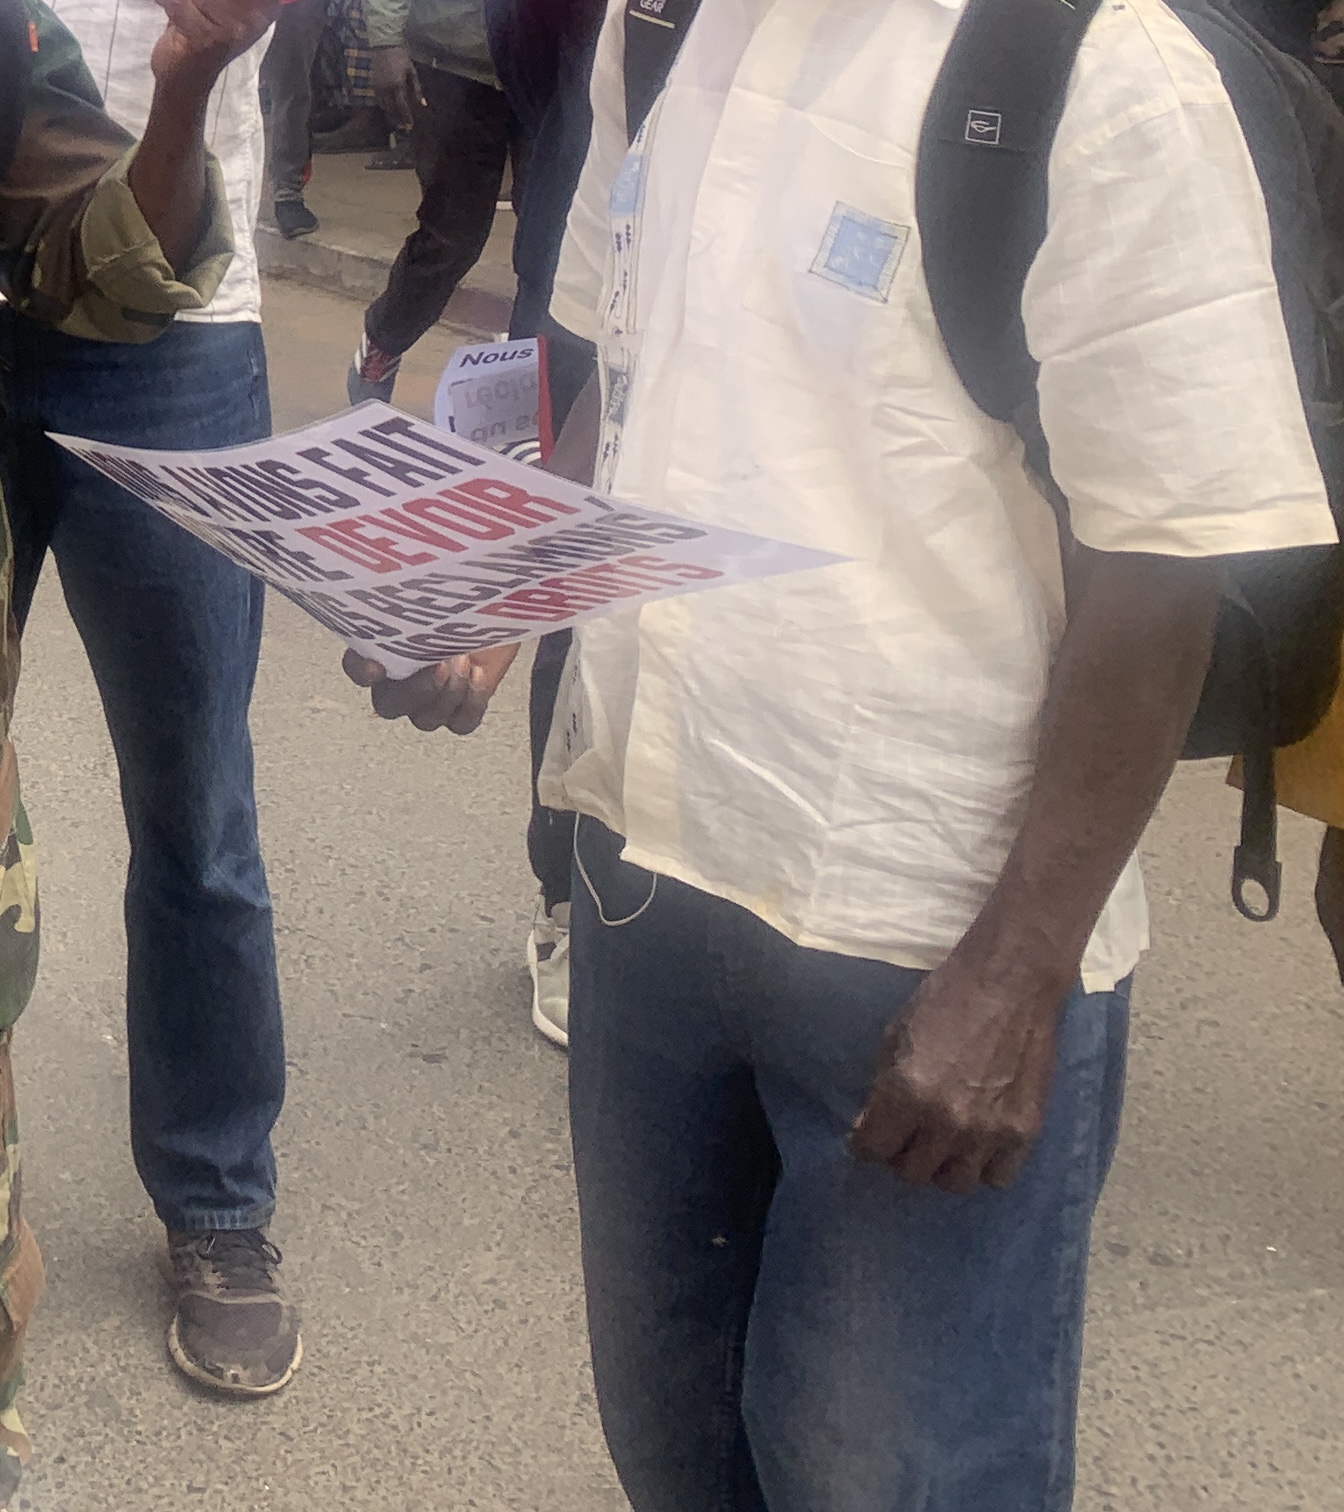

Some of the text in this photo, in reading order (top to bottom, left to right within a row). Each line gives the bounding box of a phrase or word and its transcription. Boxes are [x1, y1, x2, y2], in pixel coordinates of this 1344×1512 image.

[459, 347, 534, 367] Nous
[159, 459, 361, 523] AVONS
[296, 417, 486, 497] FAIT
[295, 477, 582, 574] DEVOIR
[345, 513, 709, 626] RECLAMONS
[375, 555, 724, 662] NOS DROITS
